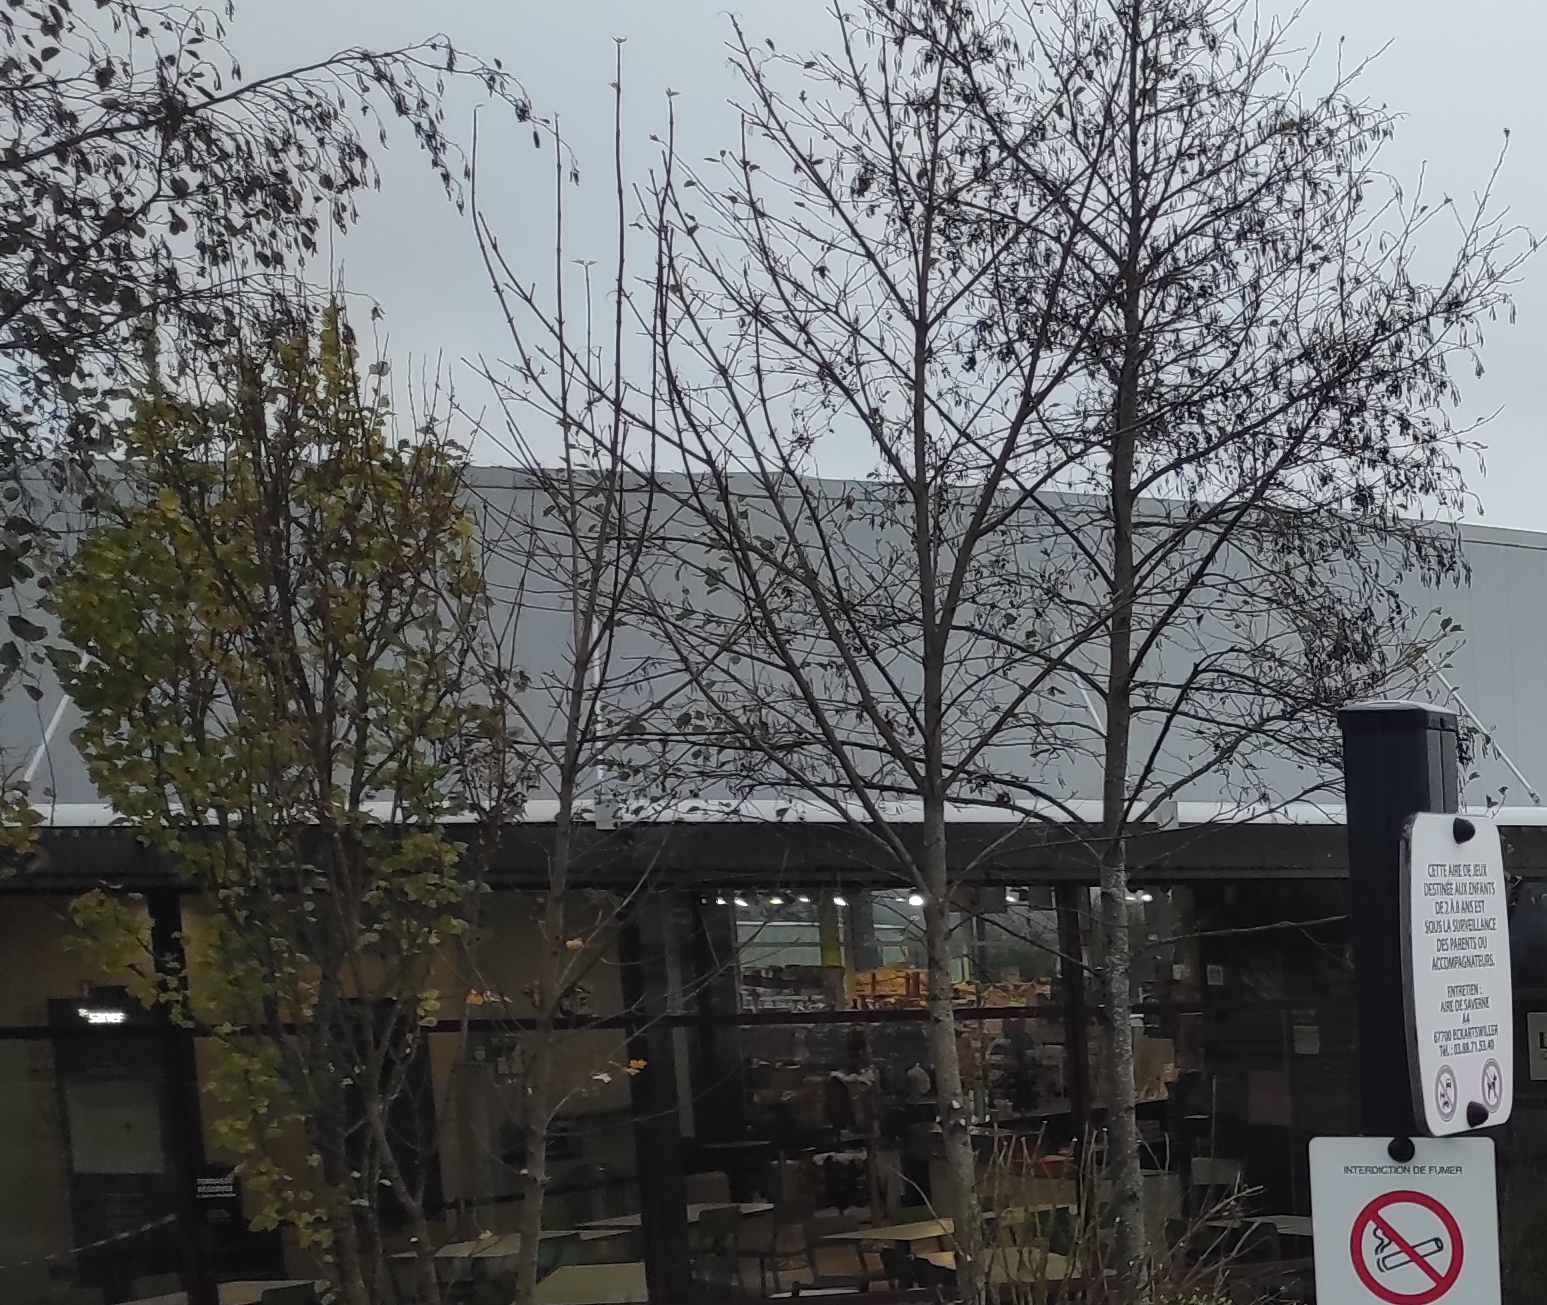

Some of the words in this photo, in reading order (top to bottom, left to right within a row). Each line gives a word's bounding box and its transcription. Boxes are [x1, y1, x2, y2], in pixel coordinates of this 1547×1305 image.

[1427, 863, 1447, 877] CETTE
[1463, 863, 1471, 877] DE
[1472, 863, 1487, 877] JEUX
[1454, 882, 1467, 895] AUX
[1468, 882, 1495, 895] ENFANTS
[1435, 900, 1444, 915] DE
[1460, 900, 1473, 914] ANS
[1474, 900, 1485, 913] EST
[1424, 920, 1442, 934] SOUS
[1443, 919, 1452, 933] LA
[1452, 918, 1497, 932] SURVEILLANCE
[1436, 938, 1449, 952] DES
[1449, 937, 1477, 951] PARENTS
[1477, 936, 1488, 950] OU
[1455, 999, 1463, 1012] DE
[1464, 996, 1490, 1011] SAVERNE
[1343, 1165, 1411, 1175] INTERDICTION
[1412, 1165, 1427, 1175] DE
[1428, 1165, 1463, 1175] FUMER
